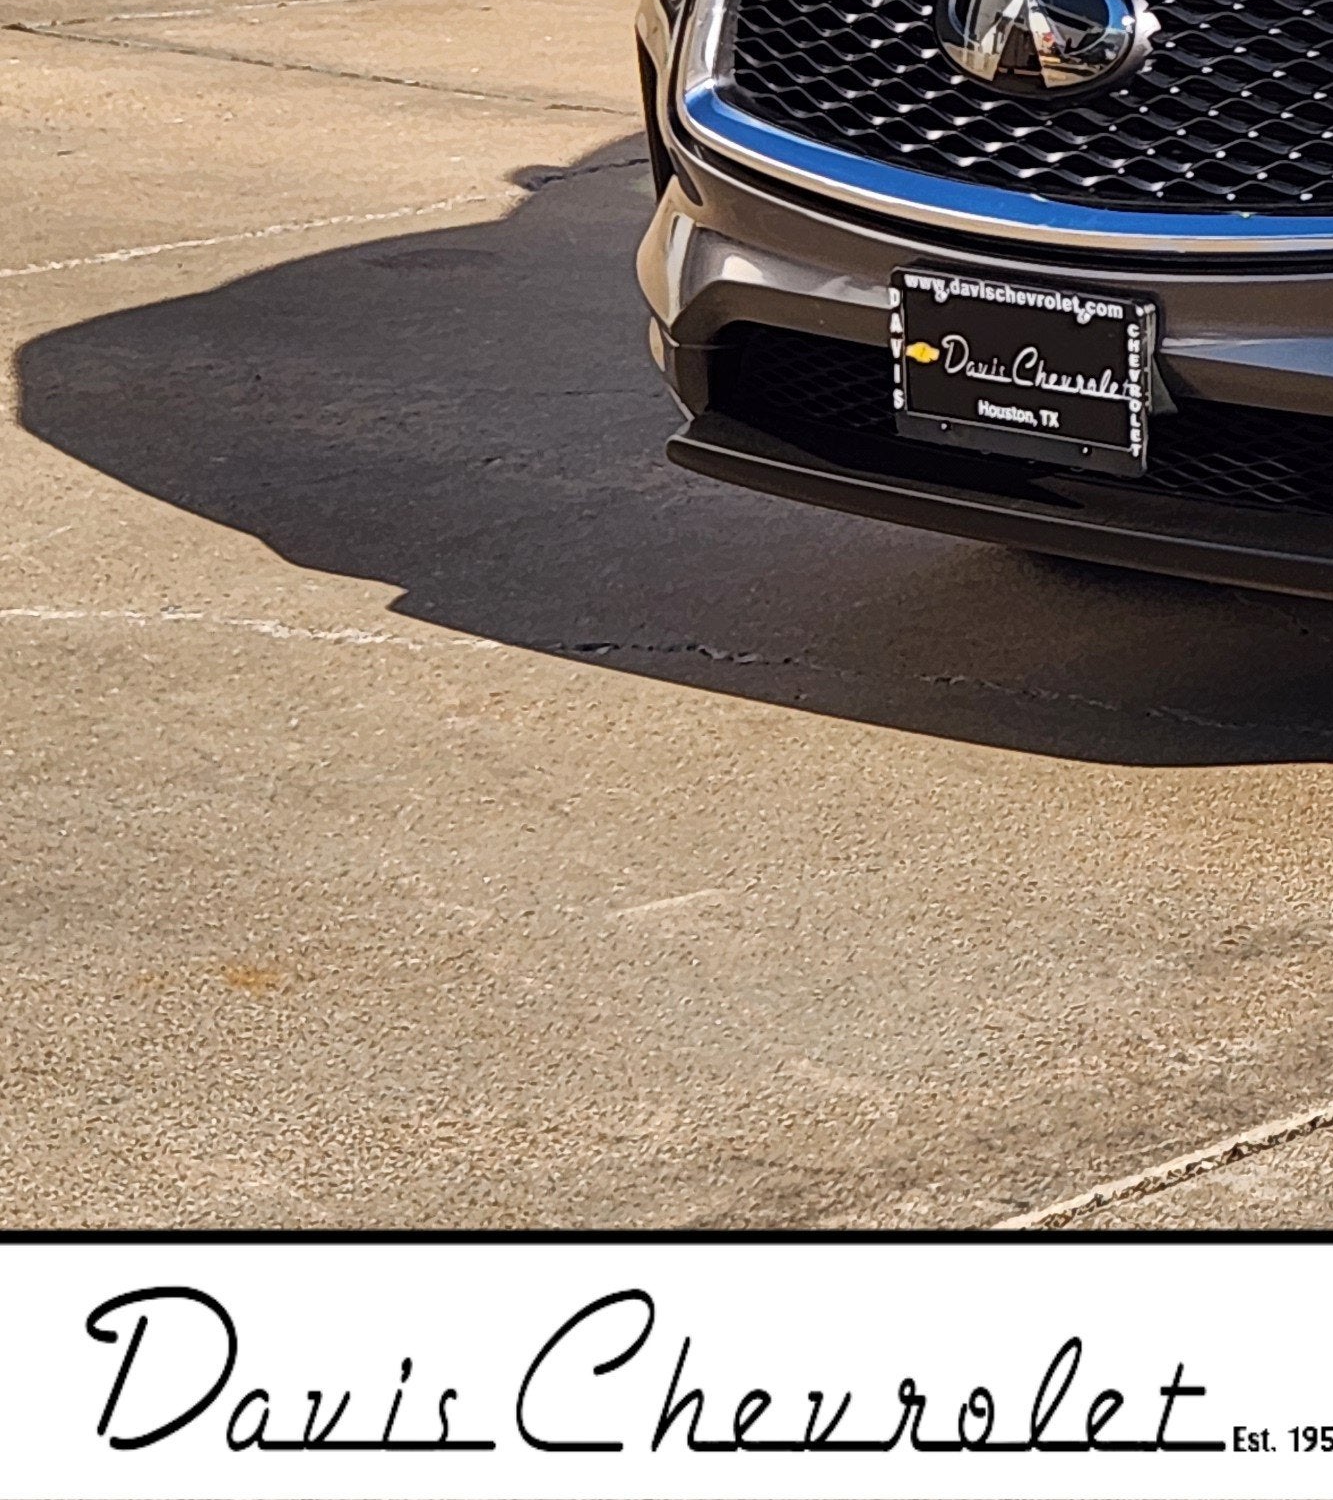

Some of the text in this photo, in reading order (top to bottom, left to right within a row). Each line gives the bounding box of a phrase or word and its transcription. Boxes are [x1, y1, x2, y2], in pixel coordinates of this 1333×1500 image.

[903, 274, 1124, 322] www.davischevrolet.com
[888, 288, 904, 410] DAVIS
[941, 334, 1131, 400] Davis Chevrolet
[977, 400, 1060, 428] Houston, TX
[1127, 323, 1142, 458] CHEVROLET
